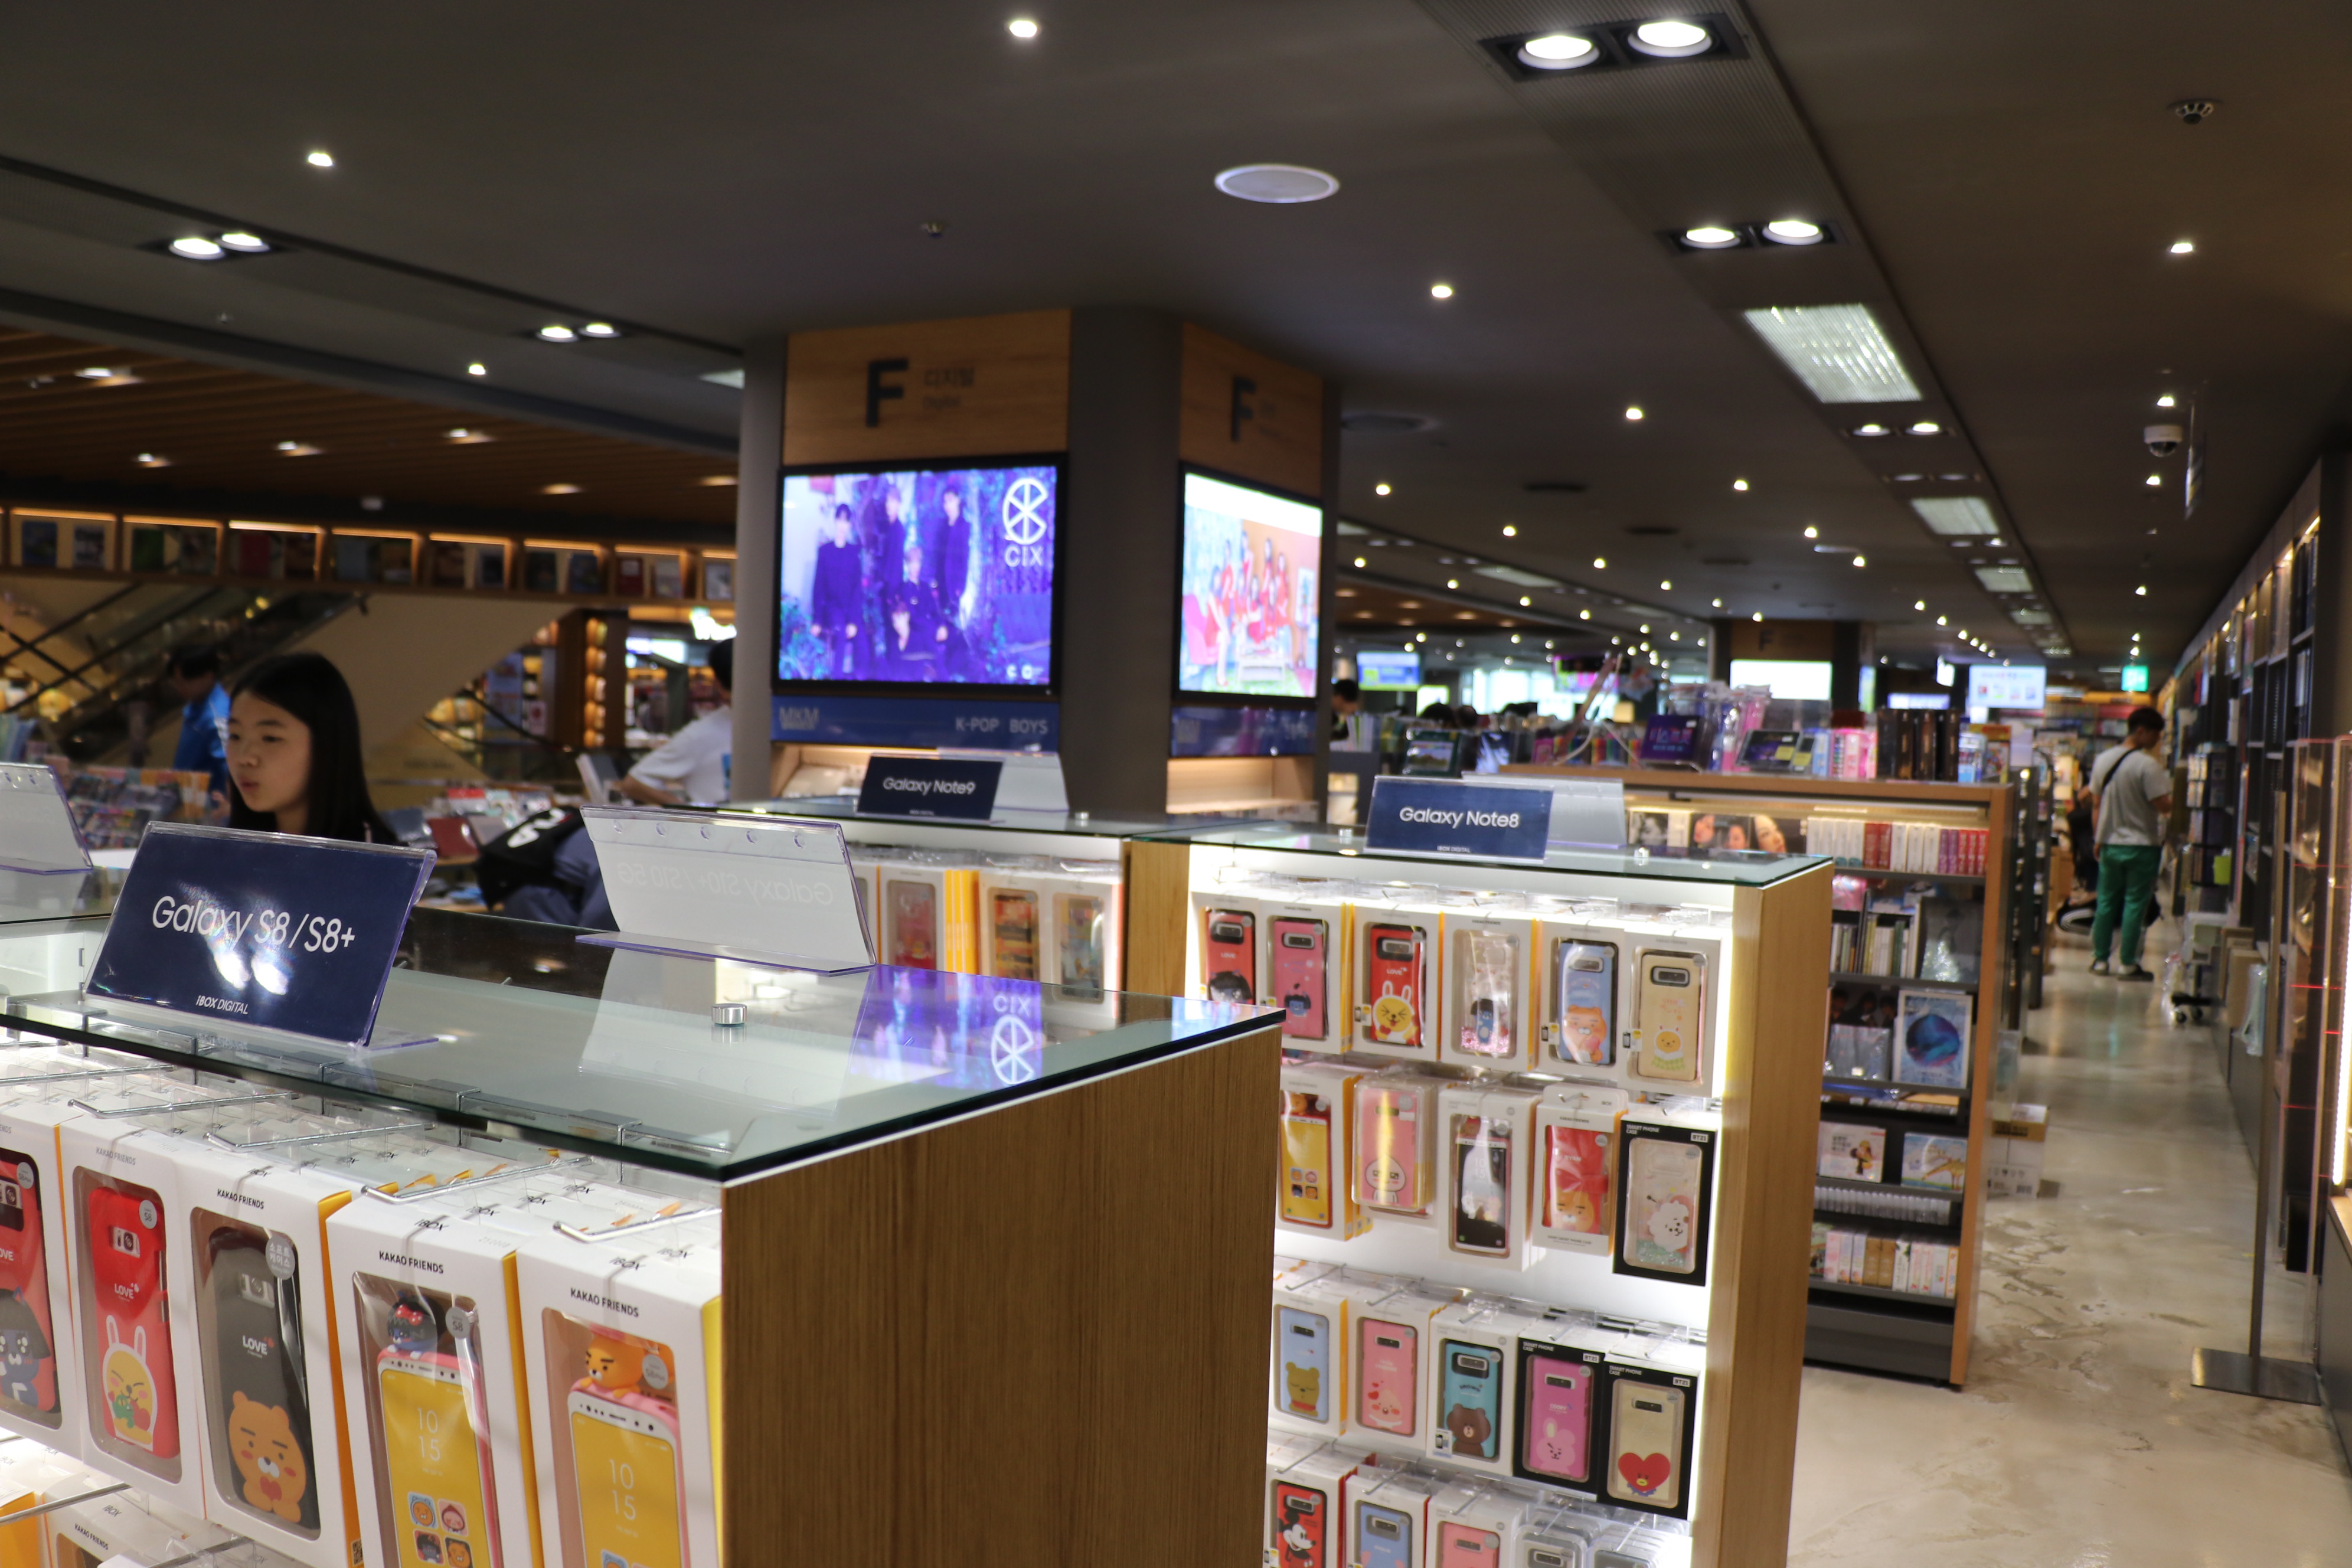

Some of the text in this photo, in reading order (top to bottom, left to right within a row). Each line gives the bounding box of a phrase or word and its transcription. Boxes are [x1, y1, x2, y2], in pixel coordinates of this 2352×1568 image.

[866, 358, 909, 429] F
[1231, 375, 1256, 442] F
[1005, 544, 1044, 567] CIX
[955, 717, 1048, 735] K-POP BOYS
[883, 777, 976, 795] Galaxy Note9
[1399, 806, 1520, 829] Galaxy Note8
[152, 896, 253, 946] Galaxy
[217, 999, 249, 1015] DIGITAL
[96, 1147, 136, 1165] KAKAO FRIENDS
[217, 1188, 264, 1210] KAKAO FRIENDS
[269, 1242, 290, 1257] 소프트
[269, 1252, 290, 1268] 케이스
[379, 1250, 443, 1274] KAKAO FRIENDS
[114, 1283, 135, 1299] LOVE
[570, 1288, 639, 1318] KAKAO FRIENDS
[452, 1321, 463, 1332] S8
[242, 1335, 267, 1355] LOVE
[417, 1407, 439, 1433] 10
[419, 1435, 441, 1462] 15
[609, 1459, 634, 1489] 10
[612, 1489, 636, 1521] 15
[74, 1523, 109, 1550] KAKAO FRIENDS
